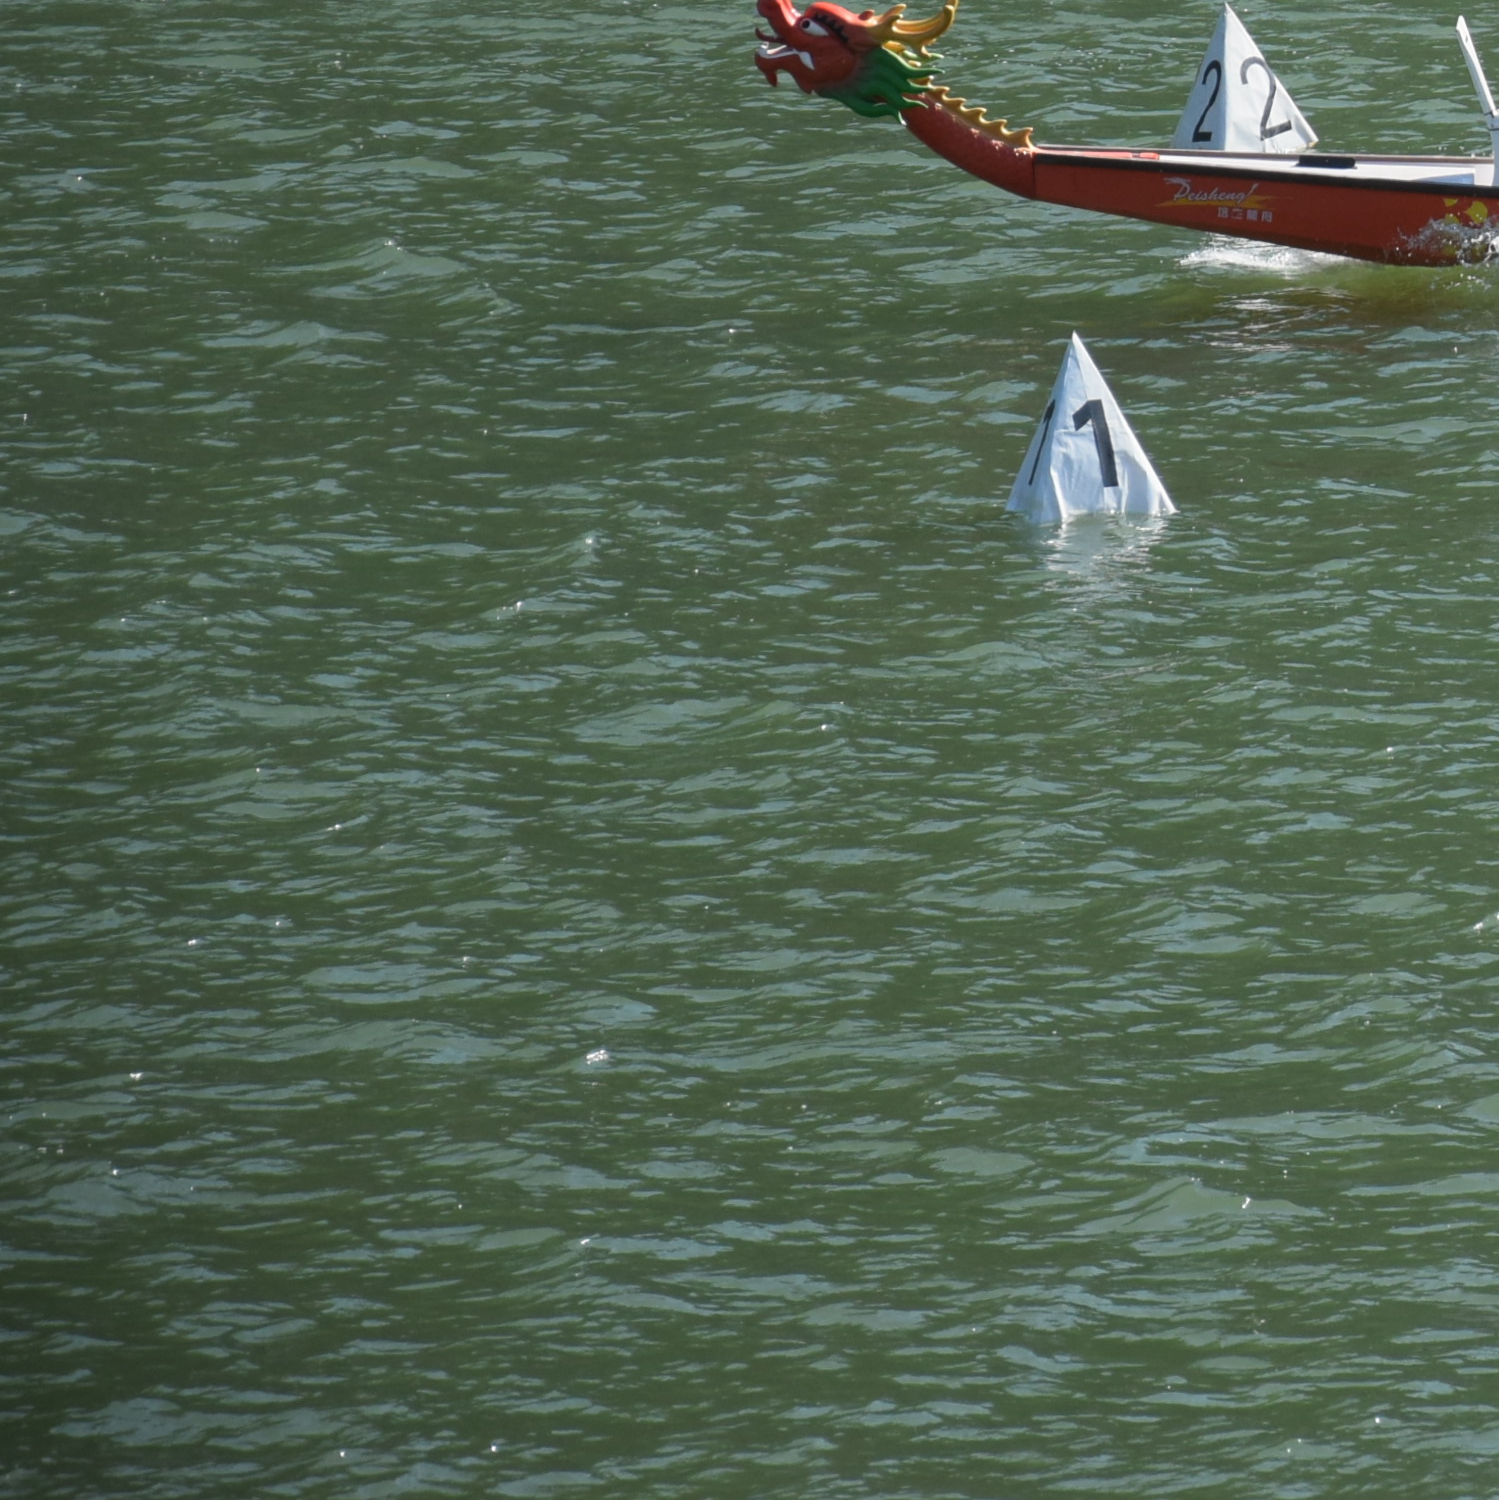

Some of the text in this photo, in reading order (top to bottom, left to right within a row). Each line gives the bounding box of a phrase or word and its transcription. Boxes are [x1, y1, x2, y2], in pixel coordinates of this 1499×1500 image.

[1192, 59, 1222, 143] 2
[1240, 56, 1293, 141] 2
[1028, 399, 1055, 486] 1
[1072, 399, 1119, 487] 1
